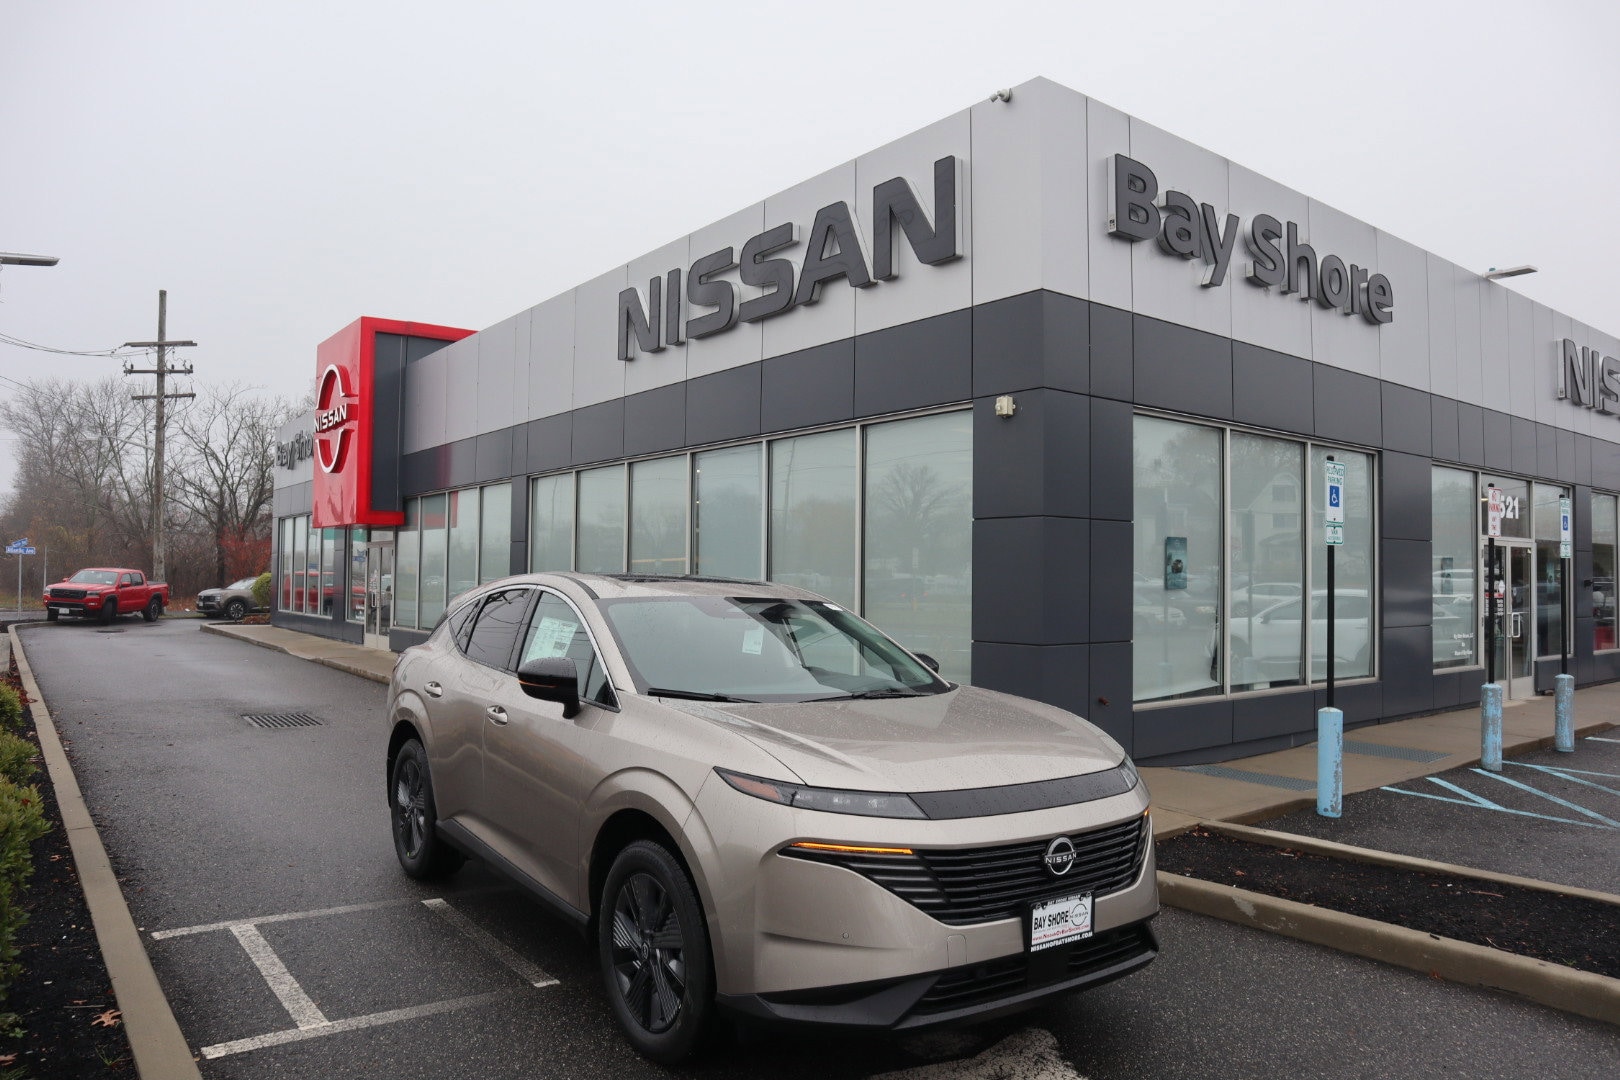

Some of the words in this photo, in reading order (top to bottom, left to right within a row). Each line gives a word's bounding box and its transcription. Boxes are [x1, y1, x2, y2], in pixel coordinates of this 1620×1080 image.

[1107, 153, 1240, 288] Bay
[1245, 213, 1394, 325] Shore
[617, 155, 962, 361] NISSAN
[314, 403, 347, 432] NISSAN
[276, 441, 295, 470] Bay
[1044, 852, 1077, 864] NISSAN
[1034, 915, 1047, 931] BAY
[1048, 910, 1069, 927] SHORE
